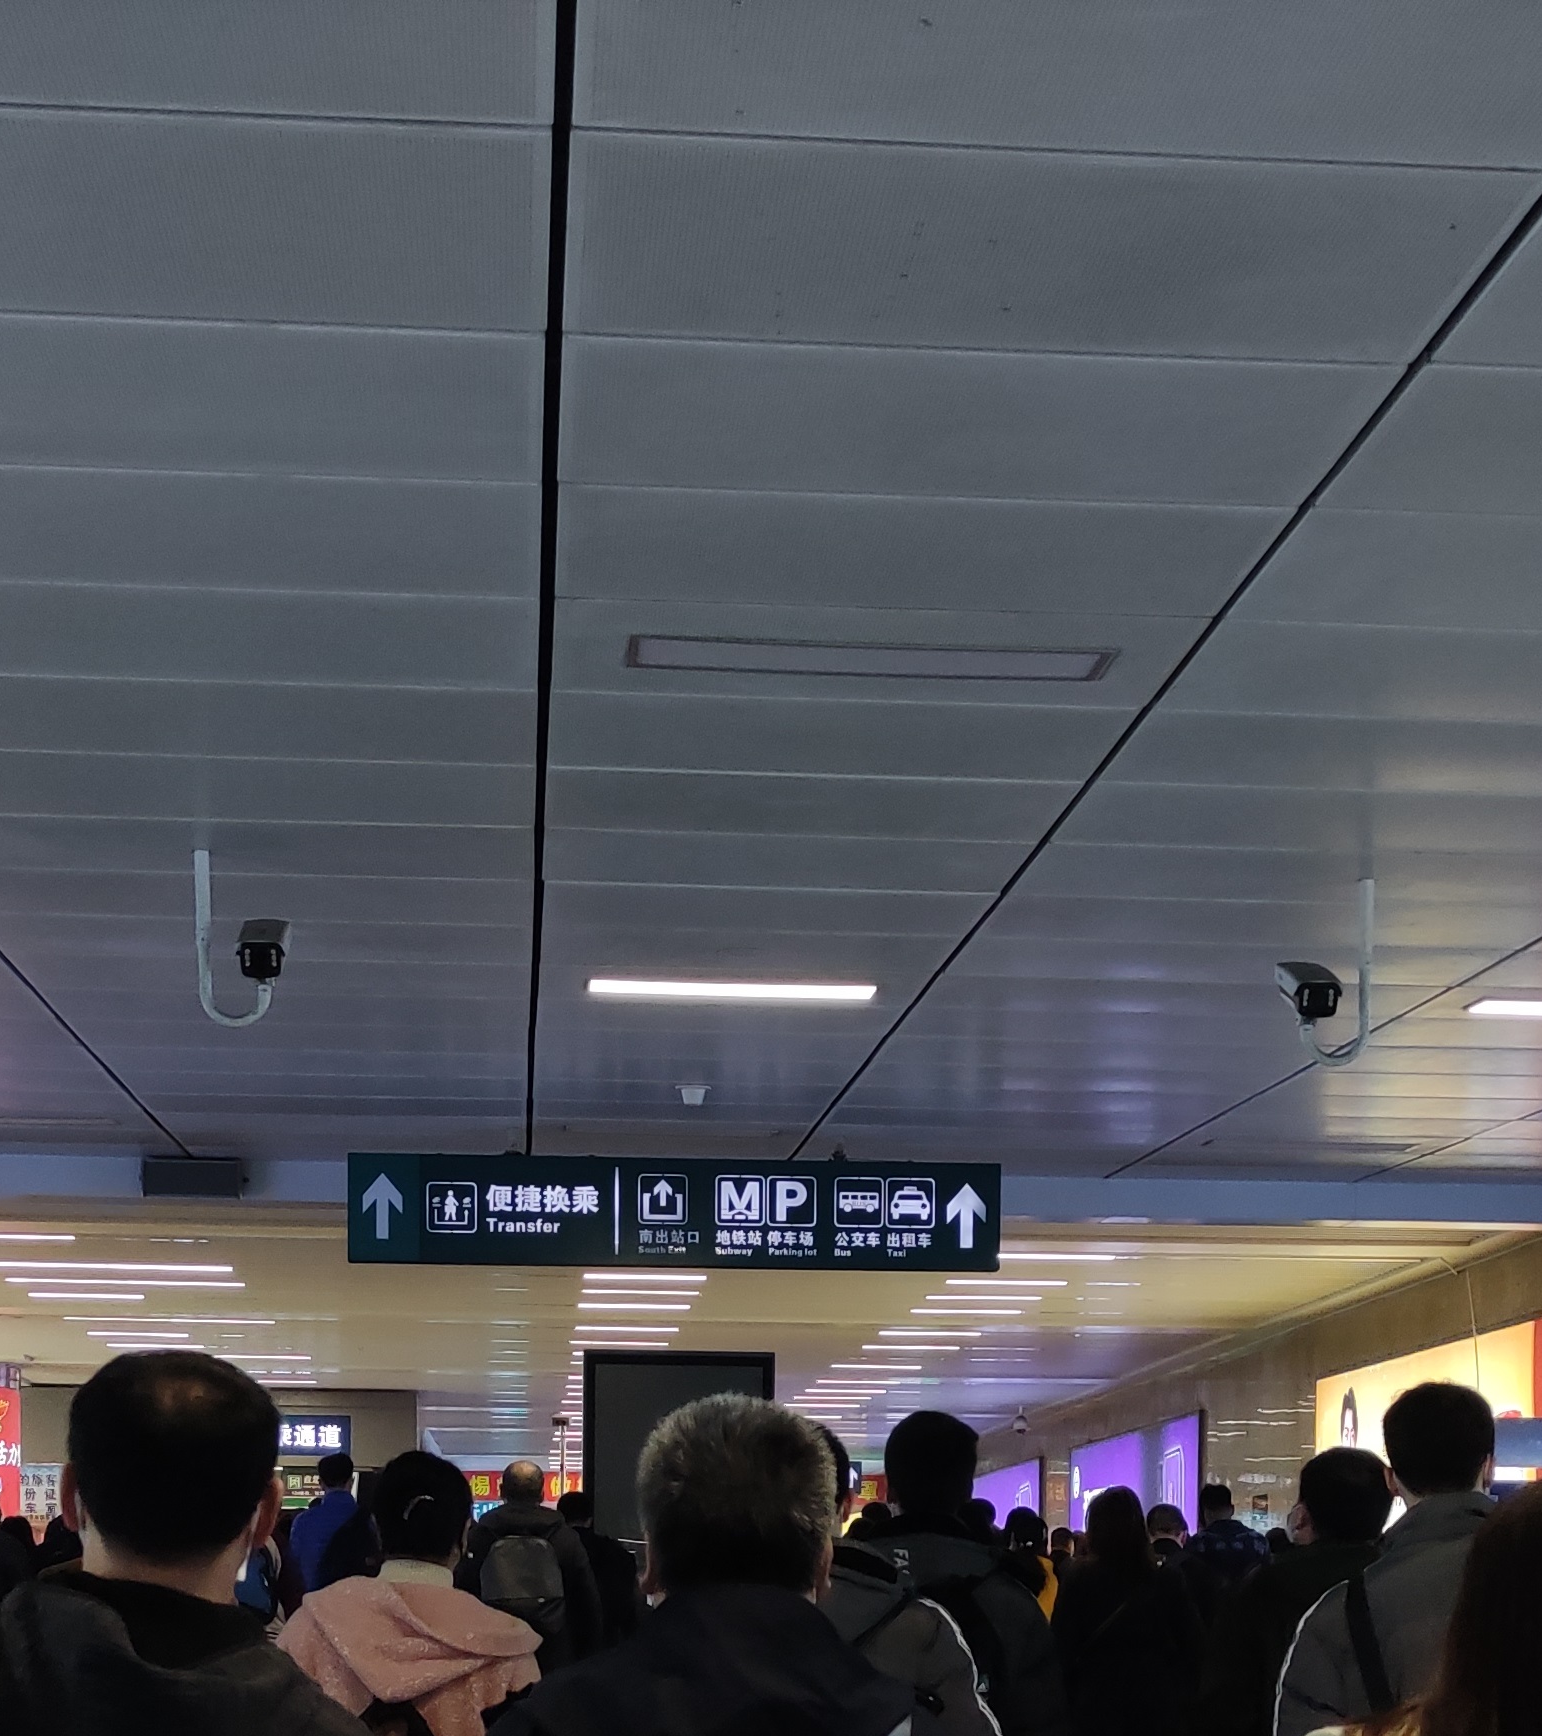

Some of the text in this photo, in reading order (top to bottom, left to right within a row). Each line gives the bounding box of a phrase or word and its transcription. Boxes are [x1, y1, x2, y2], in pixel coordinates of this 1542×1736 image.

[485, 1184, 600, 1215] 便捷换乘
[485, 1217, 561, 1234] Transfer
[638, 1229, 700, 1244] 南出站口
[715, 1230, 762, 1246] 地铁站
[766, 1230, 814, 1247] 停车场
[834, 1232, 881, 1248] 公交车
[886, 1232, 932, 1248] 出租车
[638, 1245, 687, 1254] South Exit
[714, 1246, 753, 1257] Subway
[768, 1247, 818, 1257] Parking lot
[834, 1248, 851, 1257] Bus
[887, 1248, 907, 1257] Taxi
